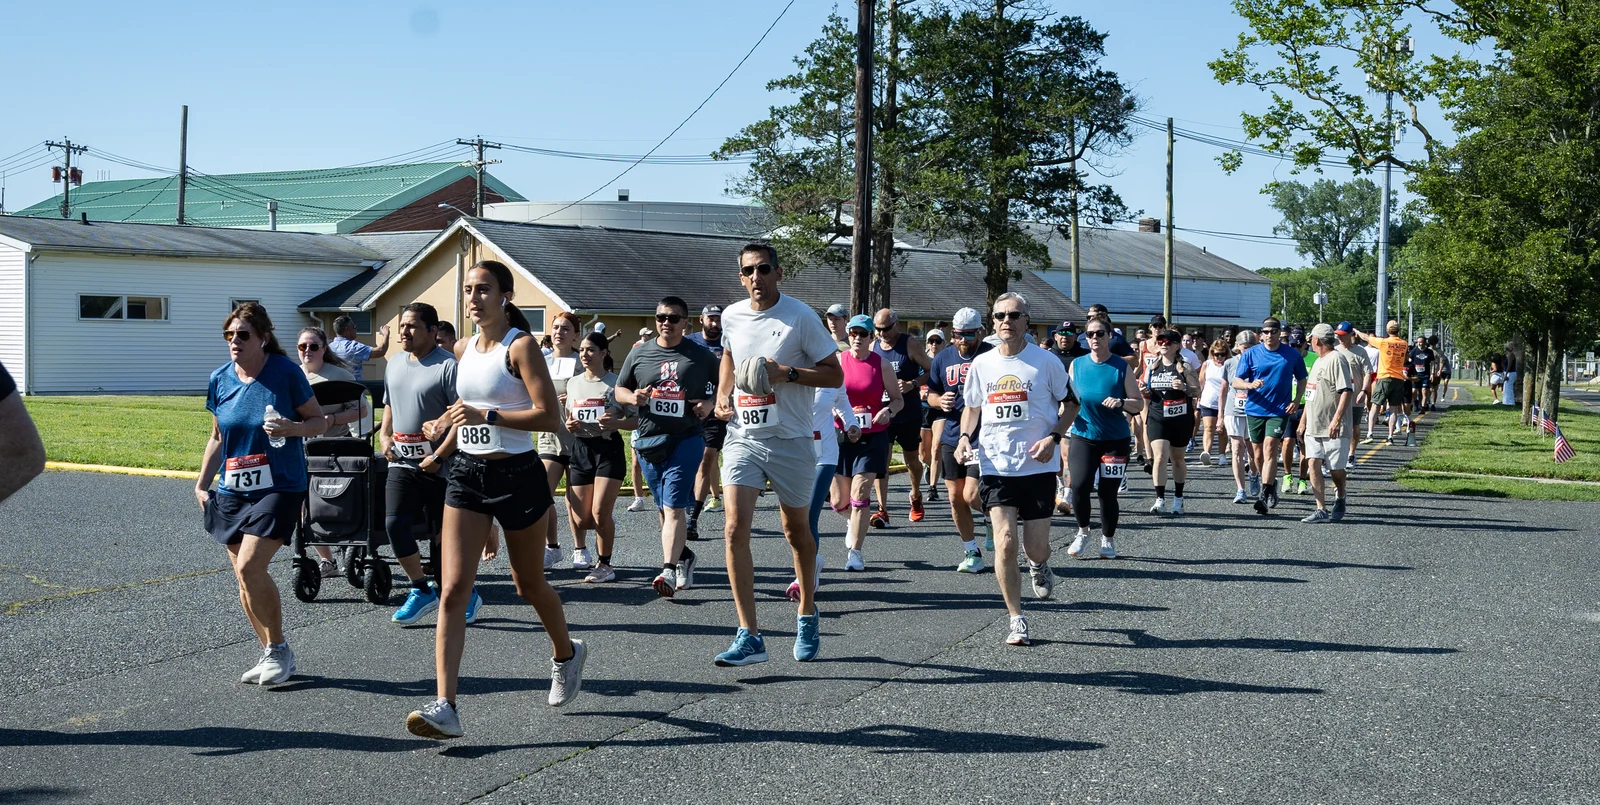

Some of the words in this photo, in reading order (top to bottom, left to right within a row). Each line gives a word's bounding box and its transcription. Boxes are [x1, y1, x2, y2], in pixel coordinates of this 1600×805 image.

[986, 381, 1008, 392] Hard
[1009, 379, 1033, 392] Rock
[655, 401, 679, 413] 630
[995, 405, 1022, 418] 979
[1168, 405, 1183, 415] 623
[577, 409, 597, 420] 671
[742, 409, 769, 425] 987
[461, 427, 491, 445] 988
[401, 445, 425, 456] 975
[1105, 465, 1123, 476] 981
[231, 470, 262, 488] 737
